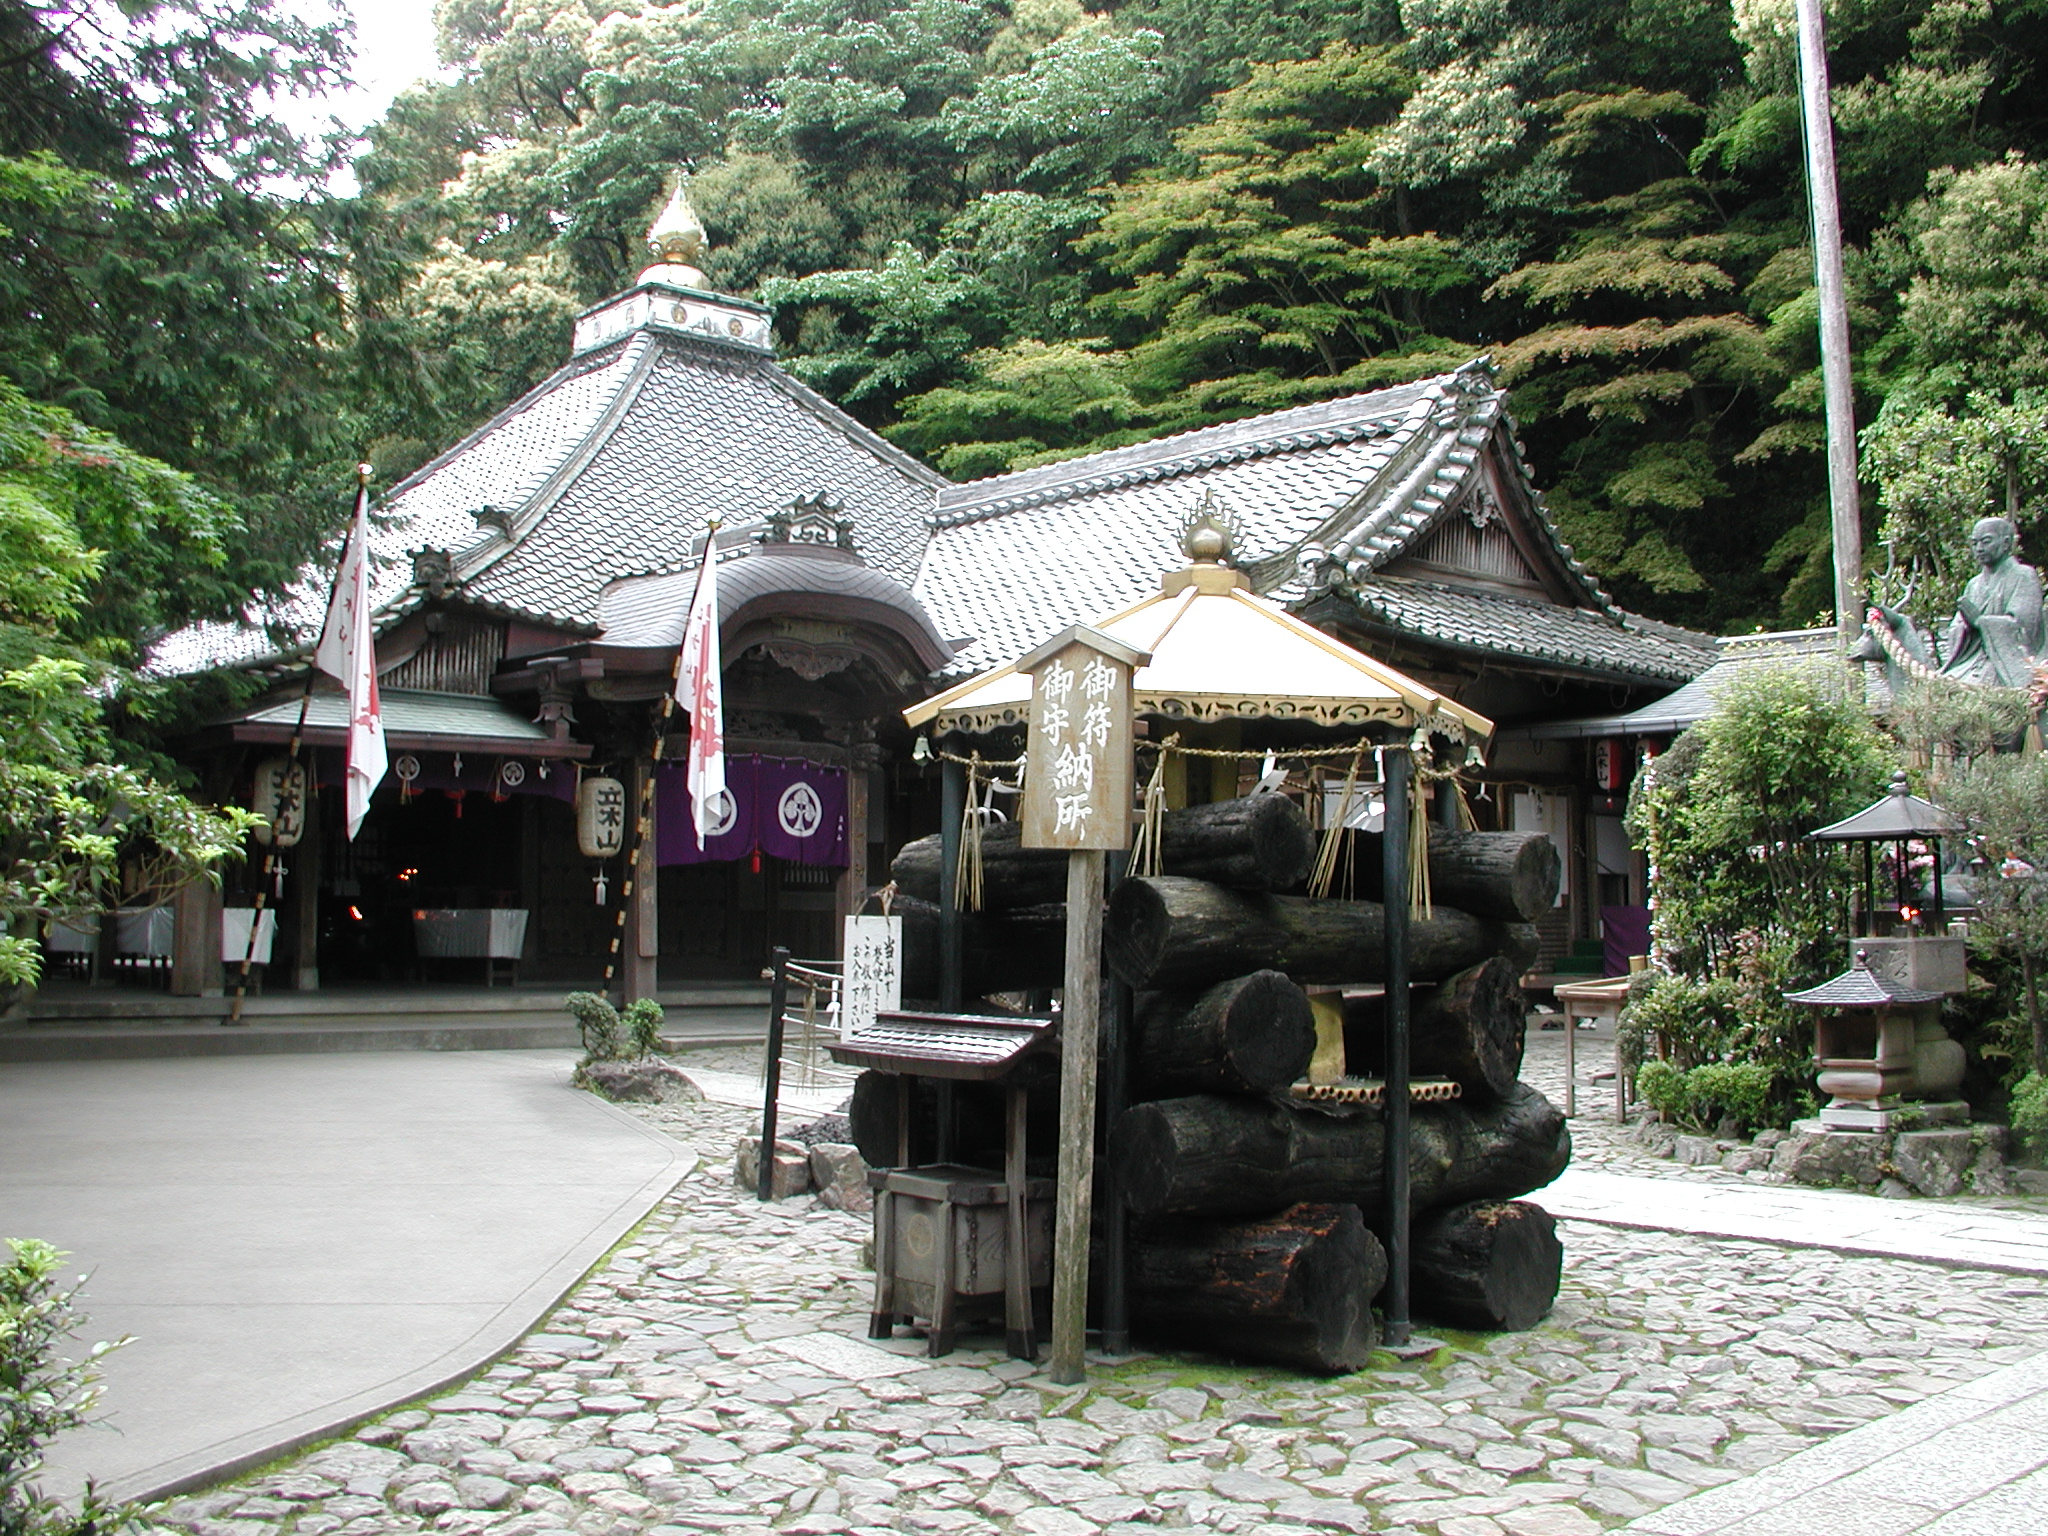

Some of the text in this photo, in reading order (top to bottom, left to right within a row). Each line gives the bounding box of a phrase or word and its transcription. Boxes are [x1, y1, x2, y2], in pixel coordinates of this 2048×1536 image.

[1038, 658, 1075, 747] 御守
[1079, 655, 1118, 748] 御符
[596, 786, 622, 850] 立木山
[1052, 741, 1093, 841] 納所
